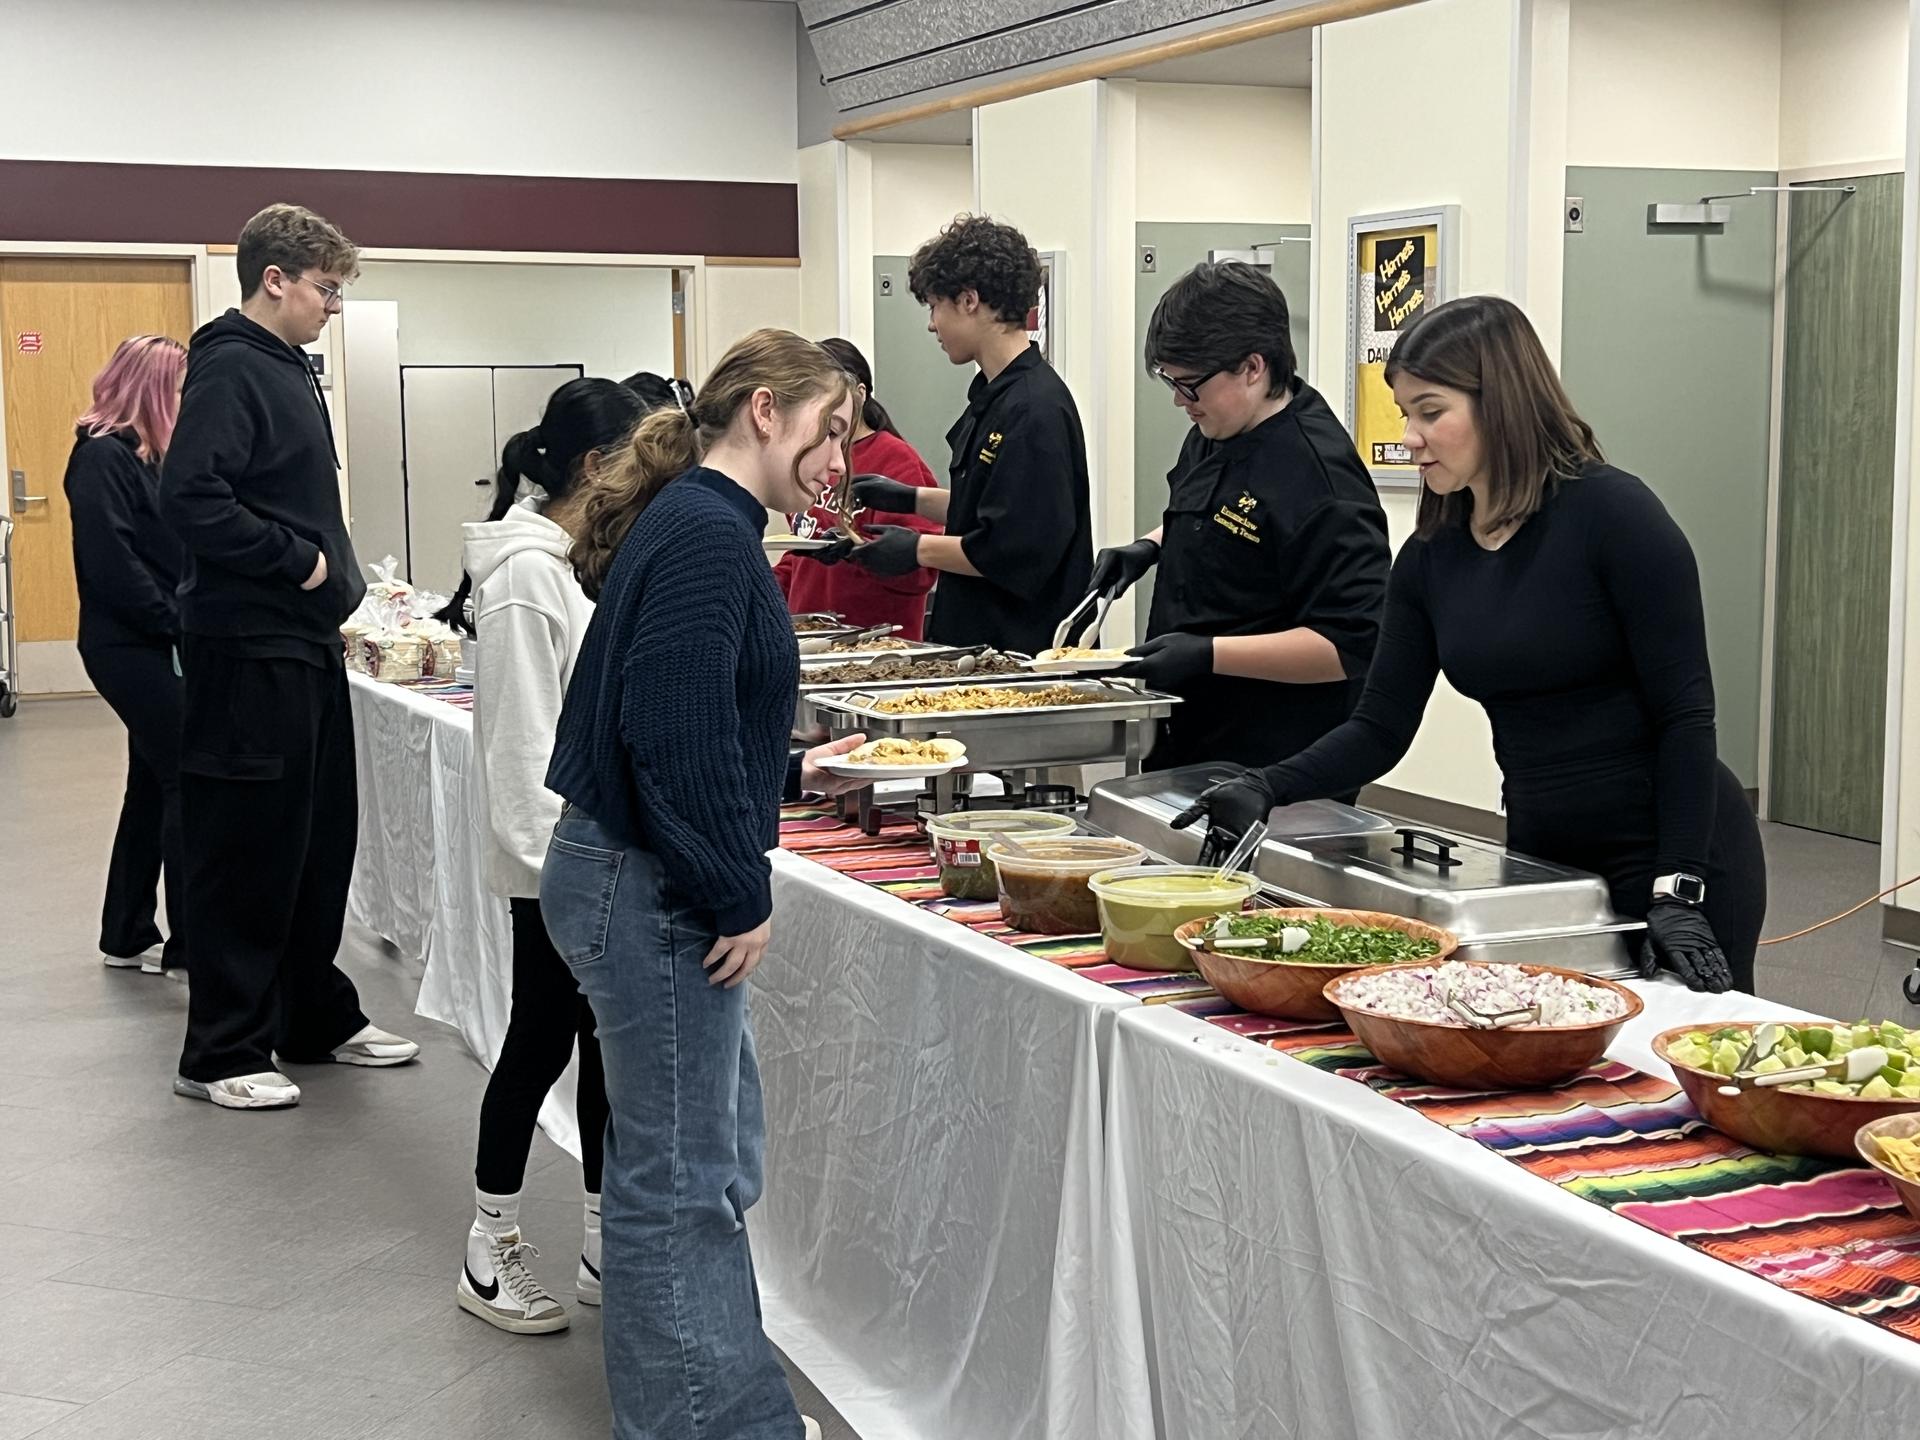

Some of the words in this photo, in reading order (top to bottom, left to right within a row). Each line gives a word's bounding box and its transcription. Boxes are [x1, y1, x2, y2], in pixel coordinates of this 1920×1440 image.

[1379, 240, 1415, 283] Hornets
[1376, 269, 1411, 314] Hornets
[1388, 289, 1424, 330] Hornets
